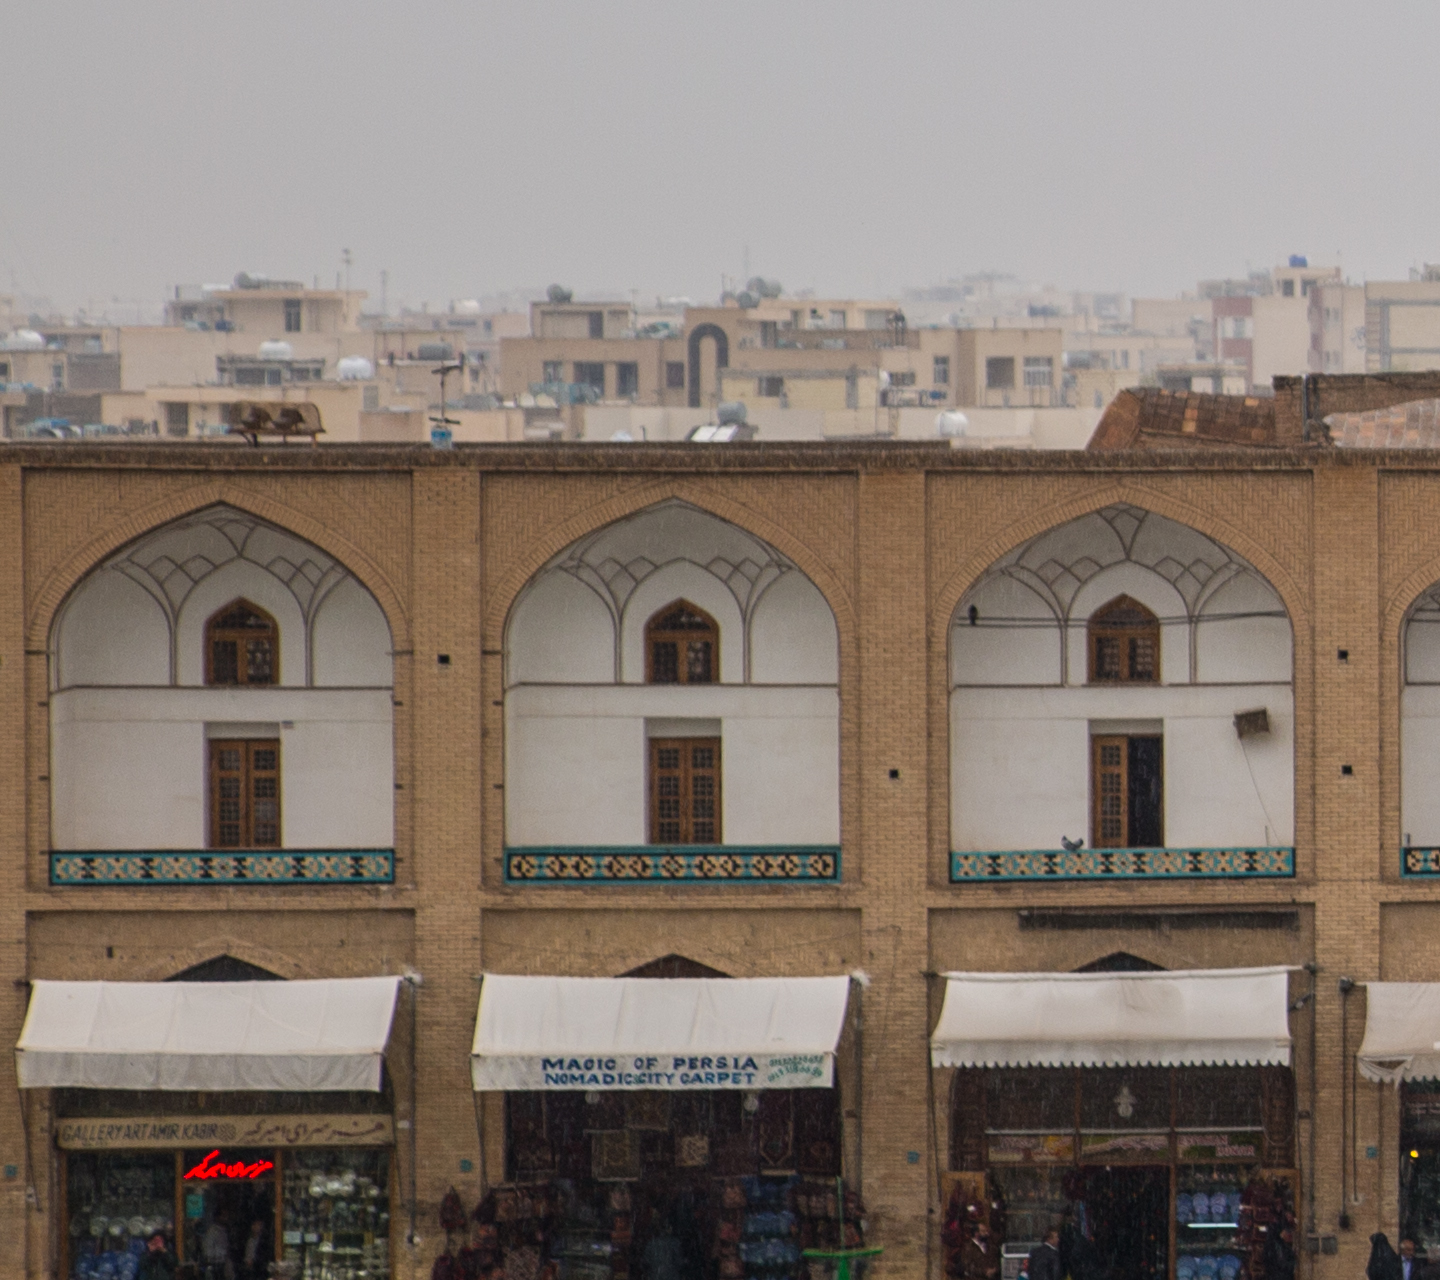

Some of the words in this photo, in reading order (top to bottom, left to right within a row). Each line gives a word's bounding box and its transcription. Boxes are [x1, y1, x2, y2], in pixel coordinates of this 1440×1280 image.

[633, 1057, 658, 1070] OF
[672, 1056, 759, 1071] PERSIA
[680, 1072, 756, 1085] CARPET
[62, 1124, 122, 1142] GALLERY
[123, 1123, 148, 1140] ART
[148, 1123, 180, 1140] AMIR
[181, 1122, 218, 1139] KABIR
